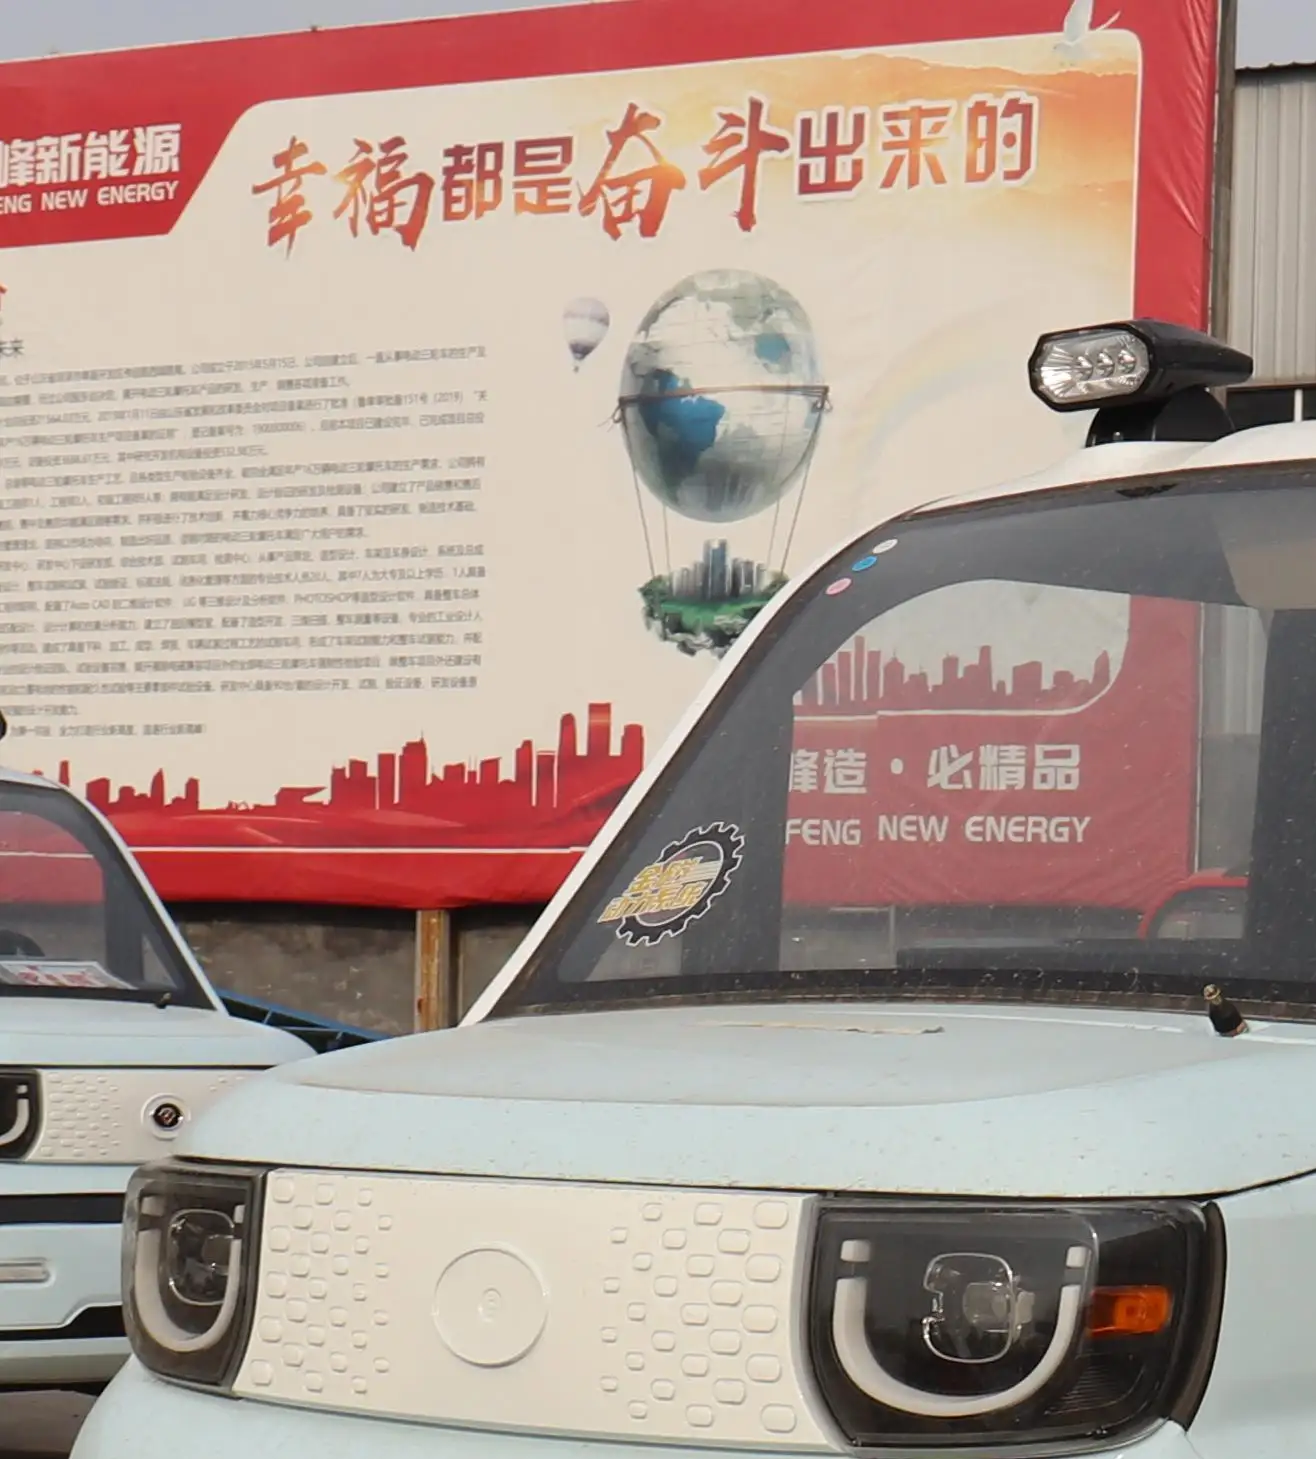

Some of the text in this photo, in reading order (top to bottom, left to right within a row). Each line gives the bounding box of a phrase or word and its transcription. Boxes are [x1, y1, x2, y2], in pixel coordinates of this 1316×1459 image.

[250, 94, 1039, 260] 幸福都是奋斗出来的
[41, 189, 88, 211] NEW
[97, 181, 179, 205] ENERGY
[785, 814, 1091, 845] FENG NEW ENERGY
